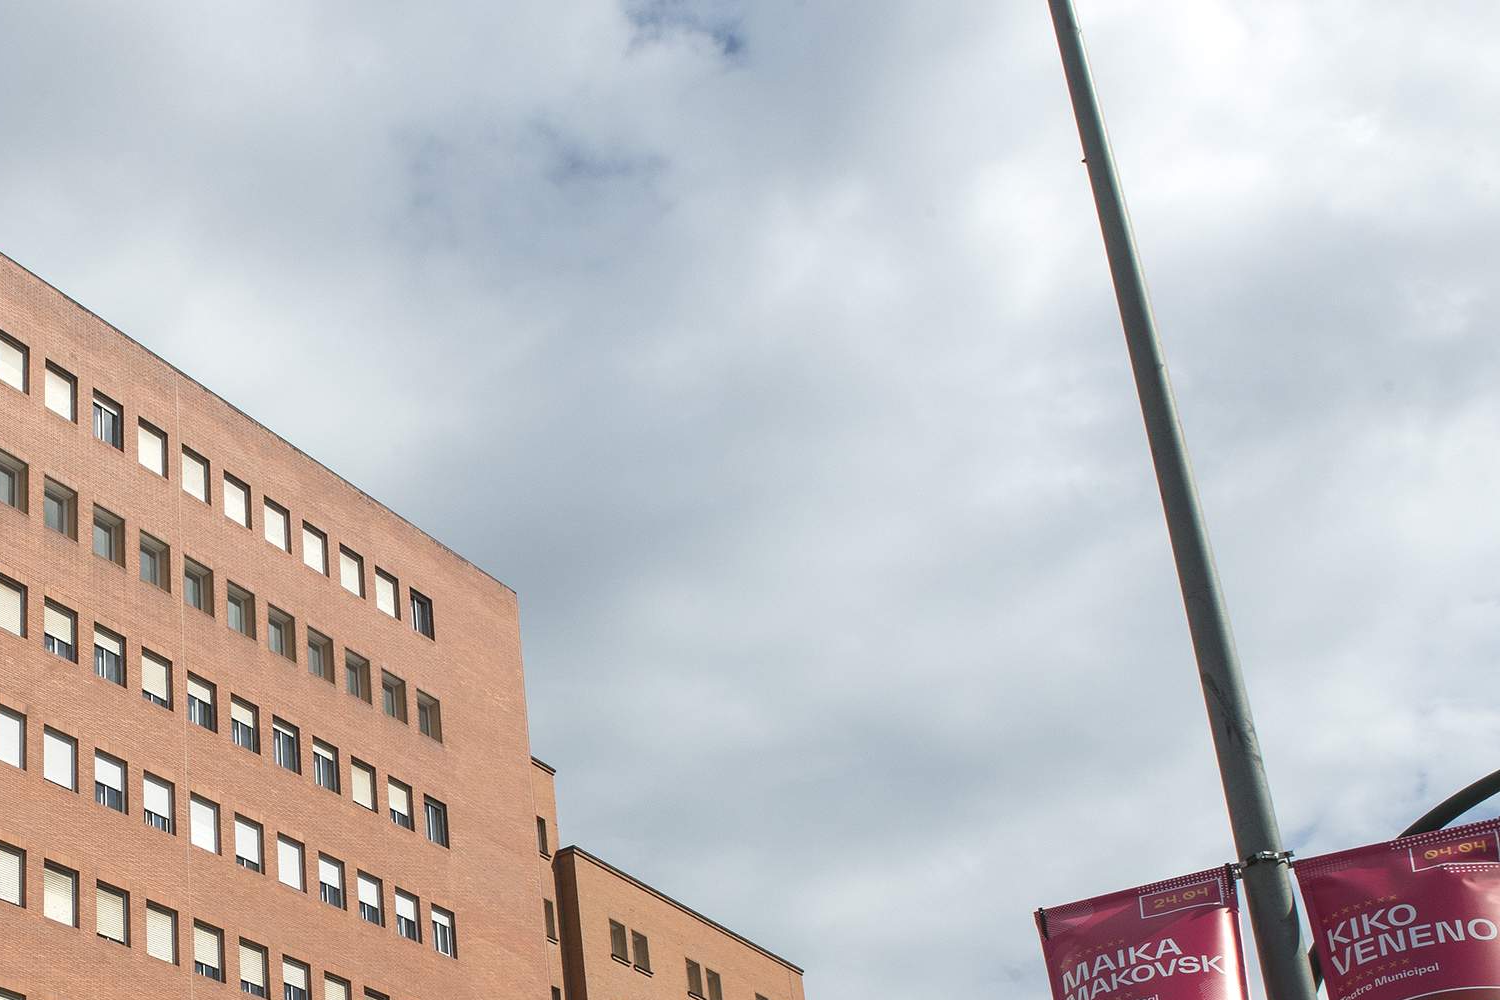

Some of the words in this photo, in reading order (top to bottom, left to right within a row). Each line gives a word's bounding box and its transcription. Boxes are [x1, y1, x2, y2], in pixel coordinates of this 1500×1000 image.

[1423, 839, 1487, 861] 04.04
[1153, 887, 1209, 909] 24.04
[1327, 903, 1418, 953] KIKO
[1331, 918, 1499, 976] VENENO
[1061, 937, 1183, 995] MAIKA
[1374, 962, 1440, 988] Municipal
